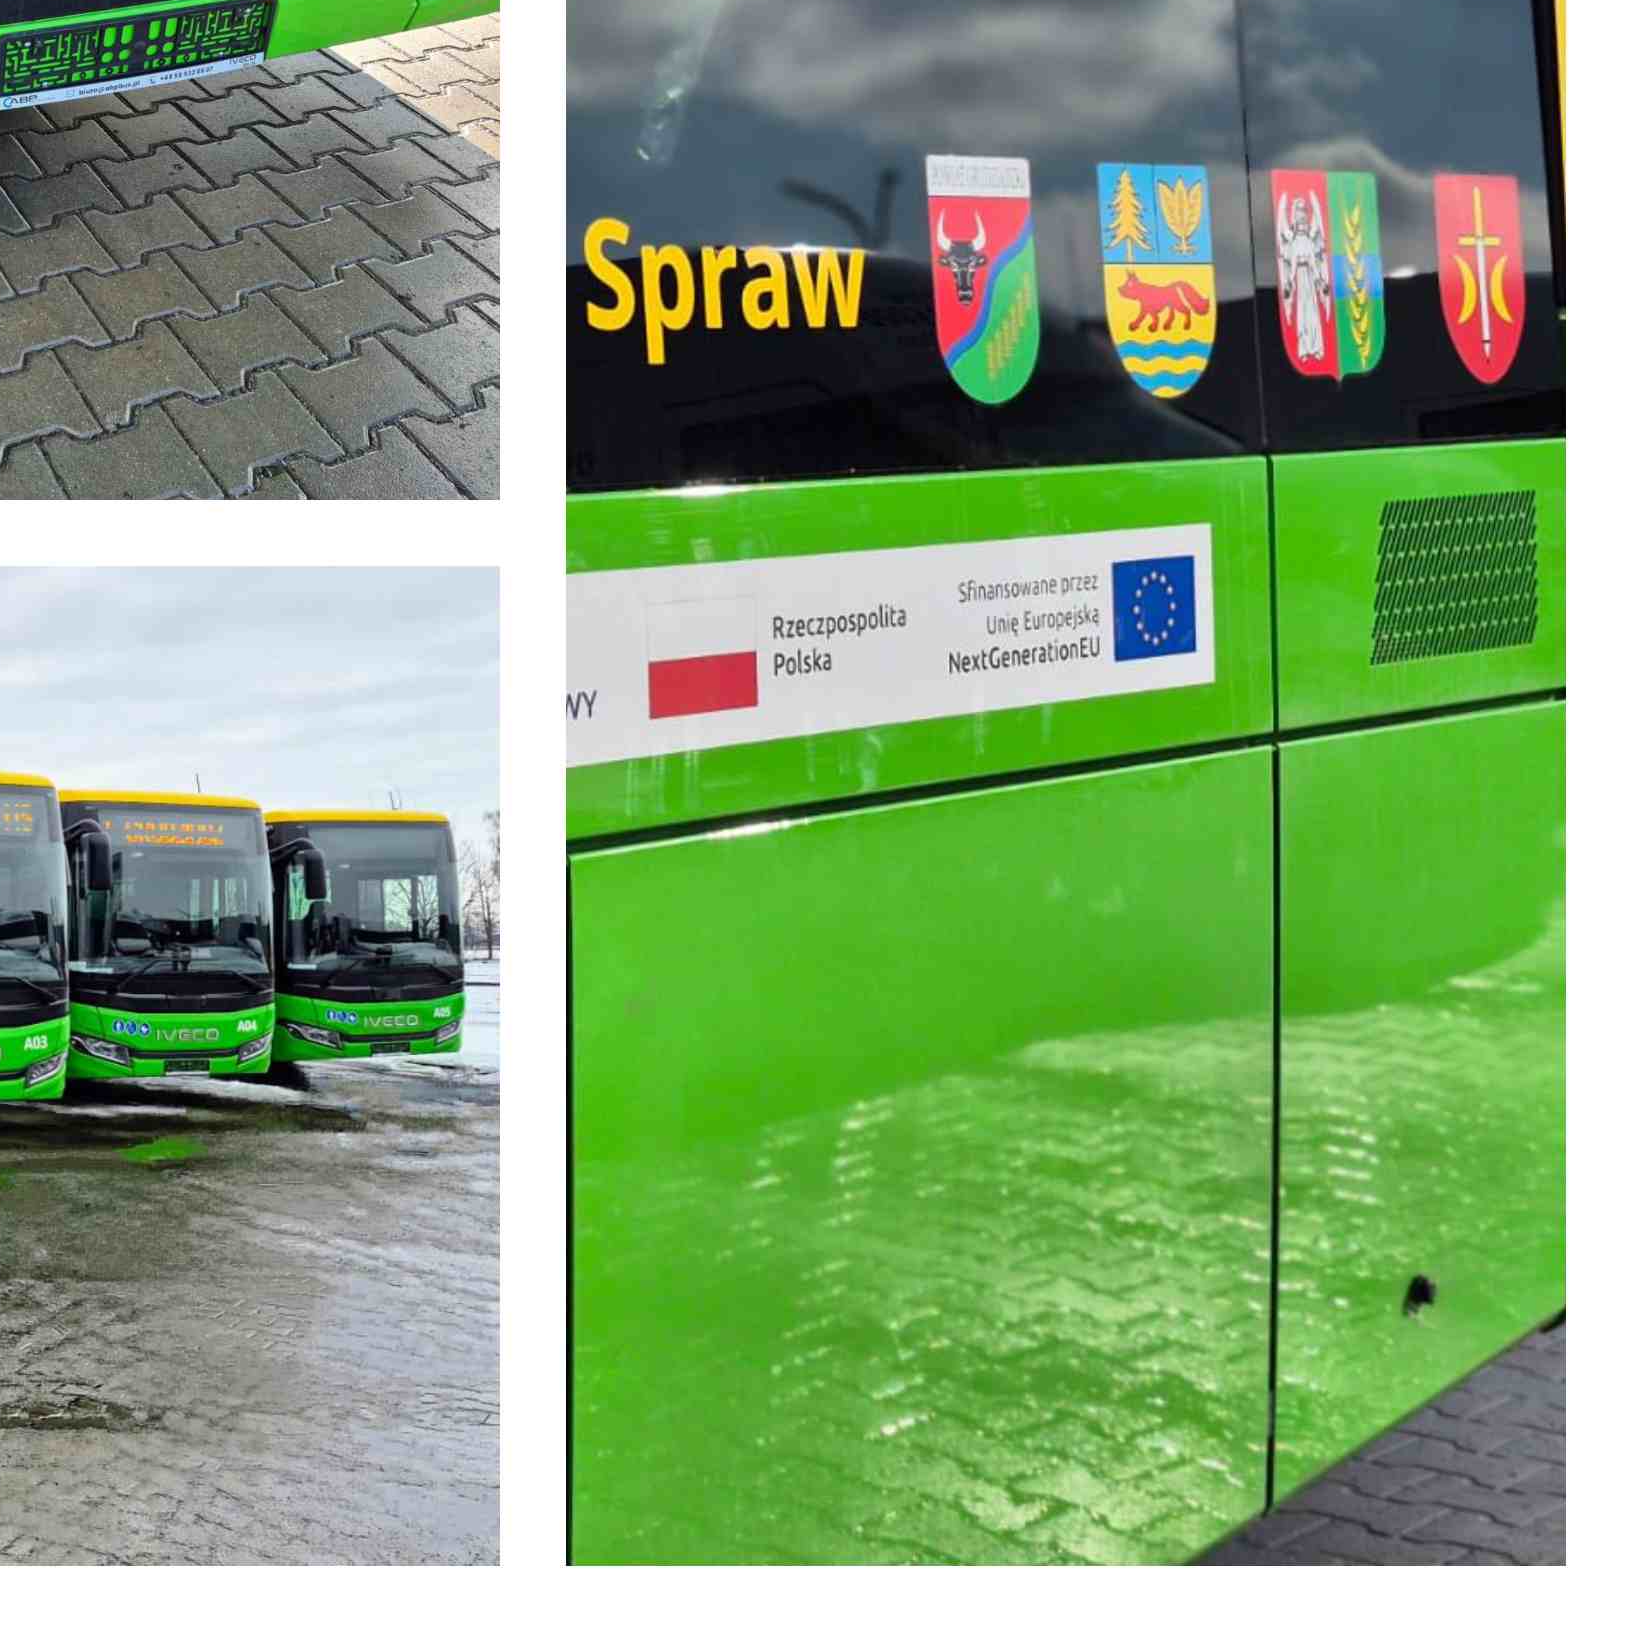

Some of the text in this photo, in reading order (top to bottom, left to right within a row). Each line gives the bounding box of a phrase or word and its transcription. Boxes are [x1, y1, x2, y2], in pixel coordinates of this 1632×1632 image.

[583, 217, 865, 364] Spraw
[957, 574, 1098, 604] Sfinansowane przez
[772, 603, 907, 640] Rzeczpospolita
[986, 604, 1100, 637] Unię Europejską
[773, 648, 832, 677] Polska
[948, 636, 1101, 674] NextGenerationEU
[155, 1027, 220, 1041] IVECO
[363, 1014, 419, 1027] IVECO
[23, 1035, 48, 1050] A03
